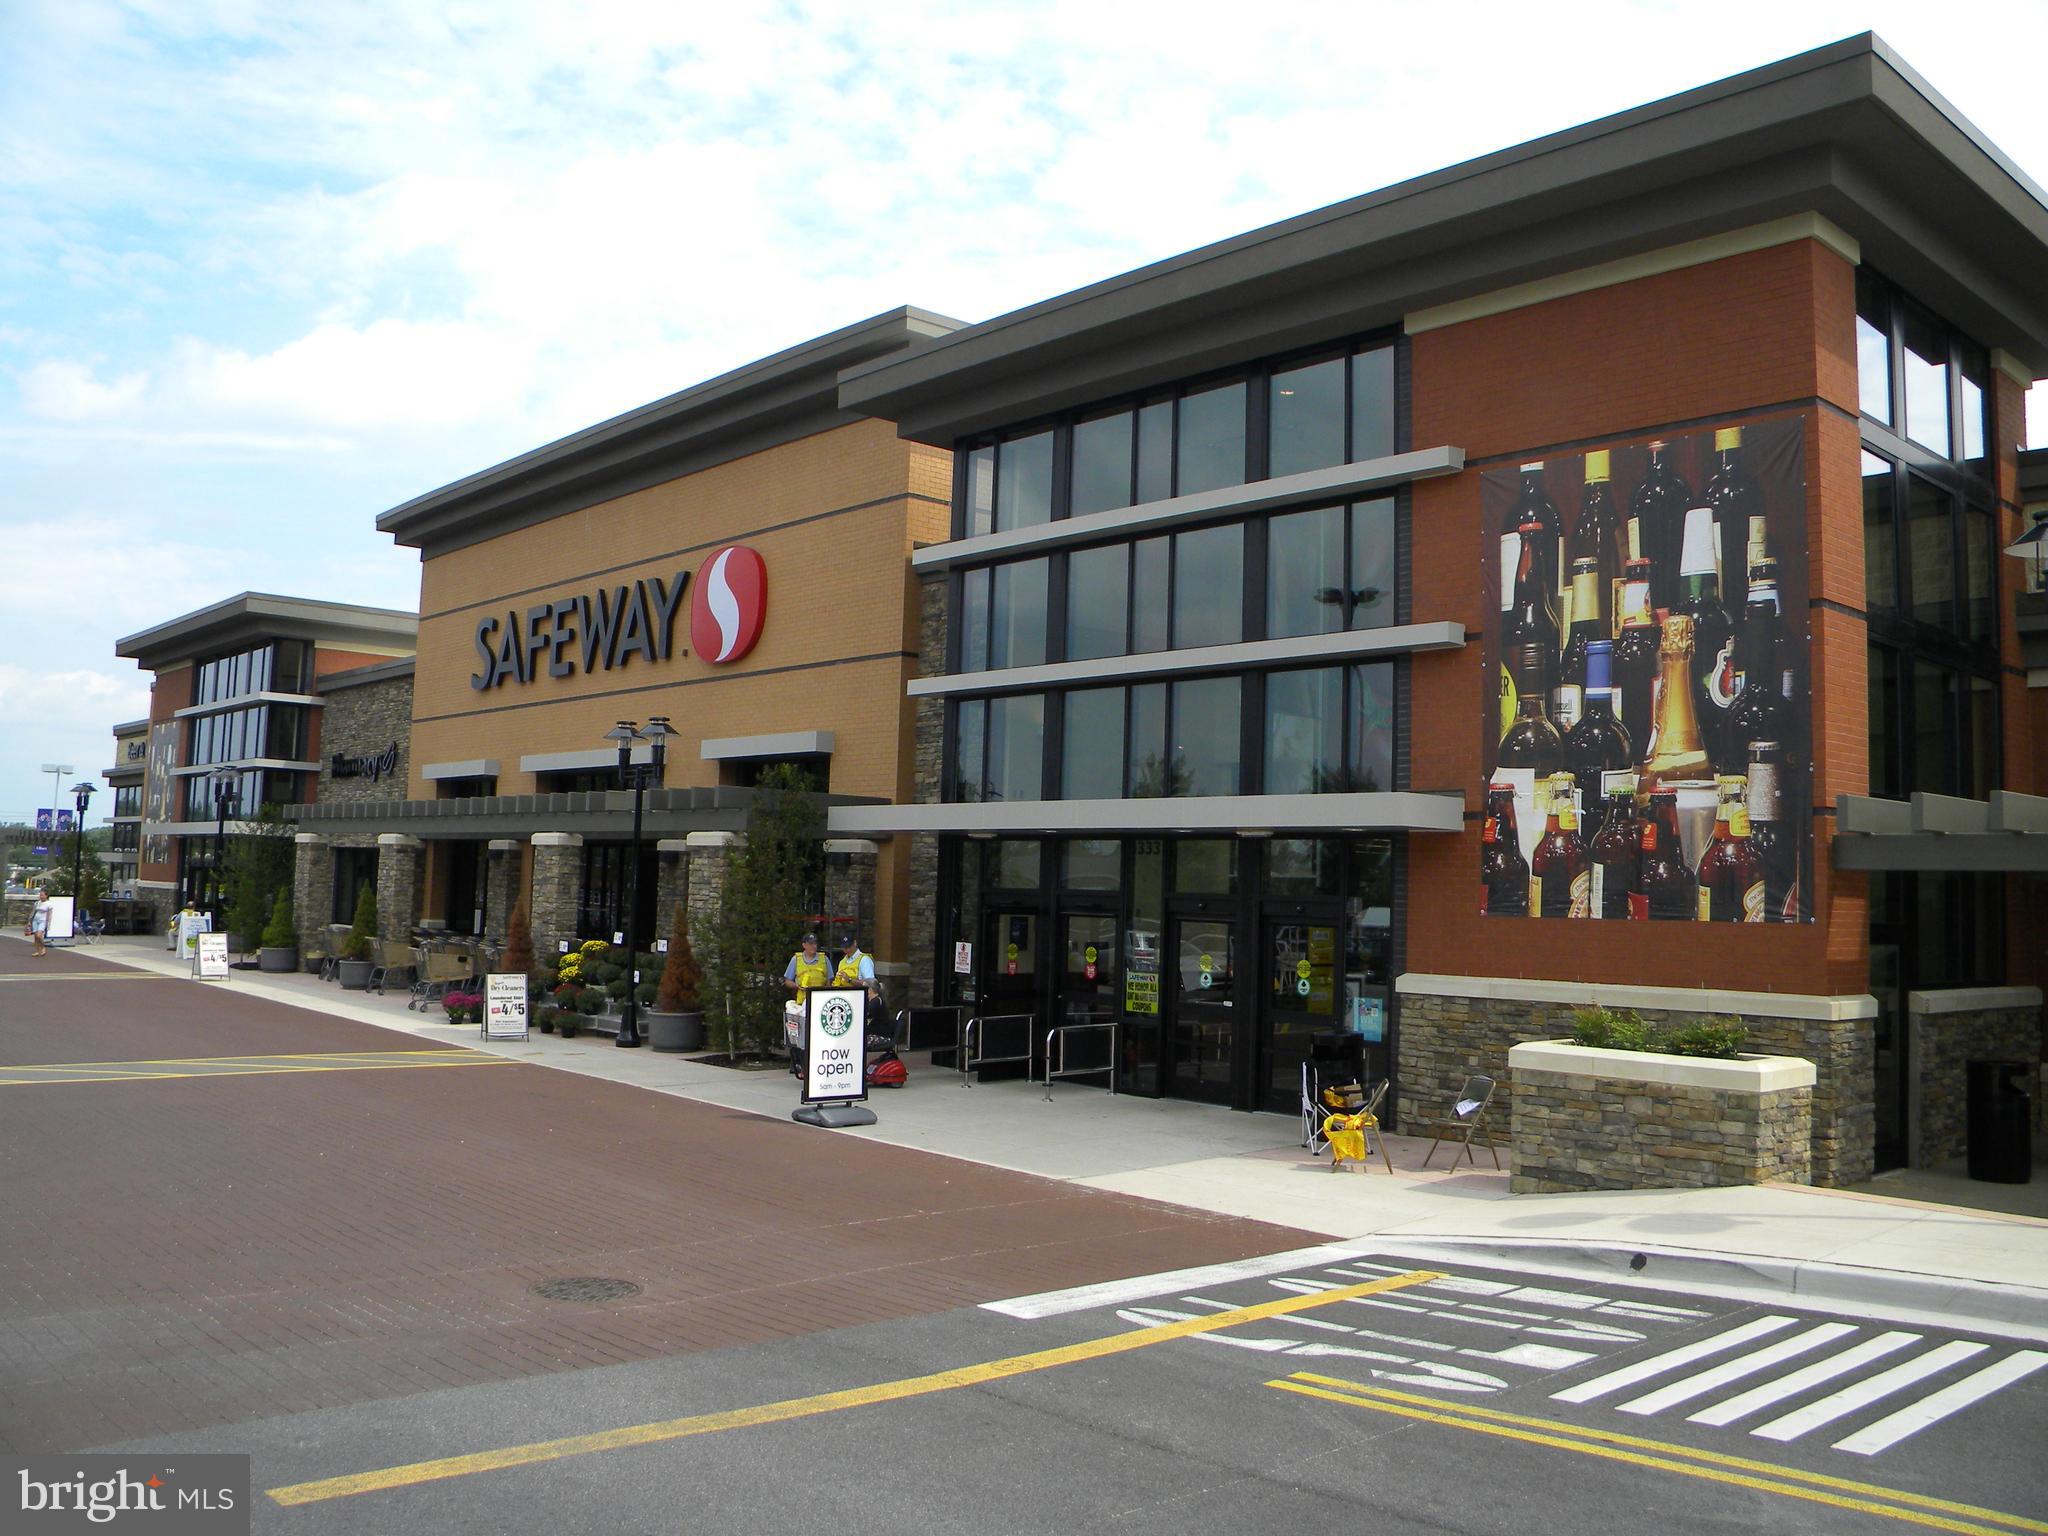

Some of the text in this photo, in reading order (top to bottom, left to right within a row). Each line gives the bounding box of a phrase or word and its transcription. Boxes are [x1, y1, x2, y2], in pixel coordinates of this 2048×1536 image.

[1137, 841, 1161, 856] 333
[502, 1003, 525, 1015] 4/$5
[822, 997, 852, 1015] STARBUCKS
[1132, 1001, 1152, 1012] COUPONS
[824, 1024, 848, 1036] COFFEE
[821, 1049, 850, 1060] now
[817, 1062, 853, 1078] open
